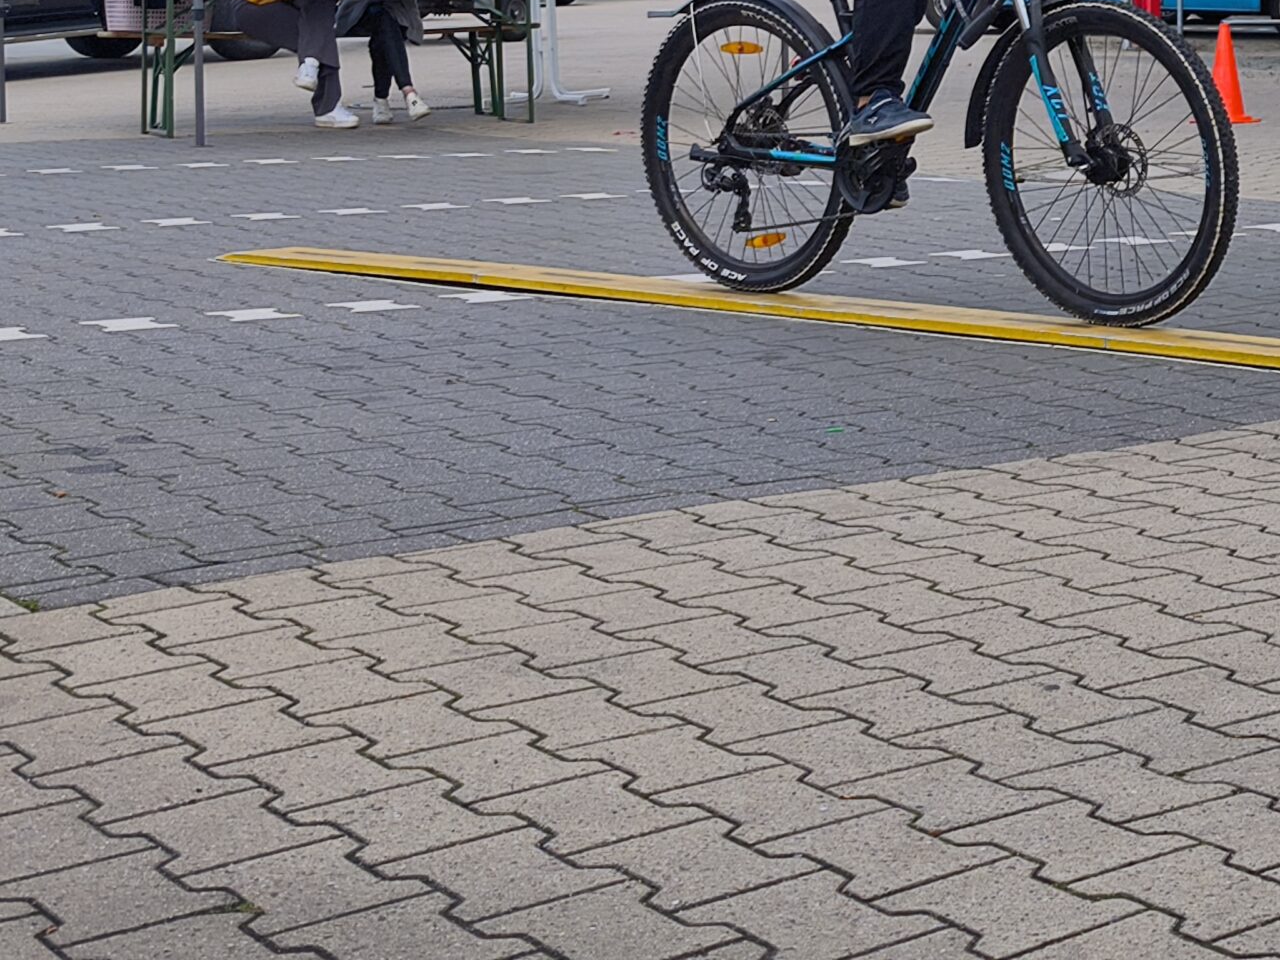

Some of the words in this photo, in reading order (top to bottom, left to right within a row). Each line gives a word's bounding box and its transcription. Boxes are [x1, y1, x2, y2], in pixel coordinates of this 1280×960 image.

[671, 221, 701, 257] PACE
[700, 257, 719, 271] OF
[720, 268, 747, 281] ACE
